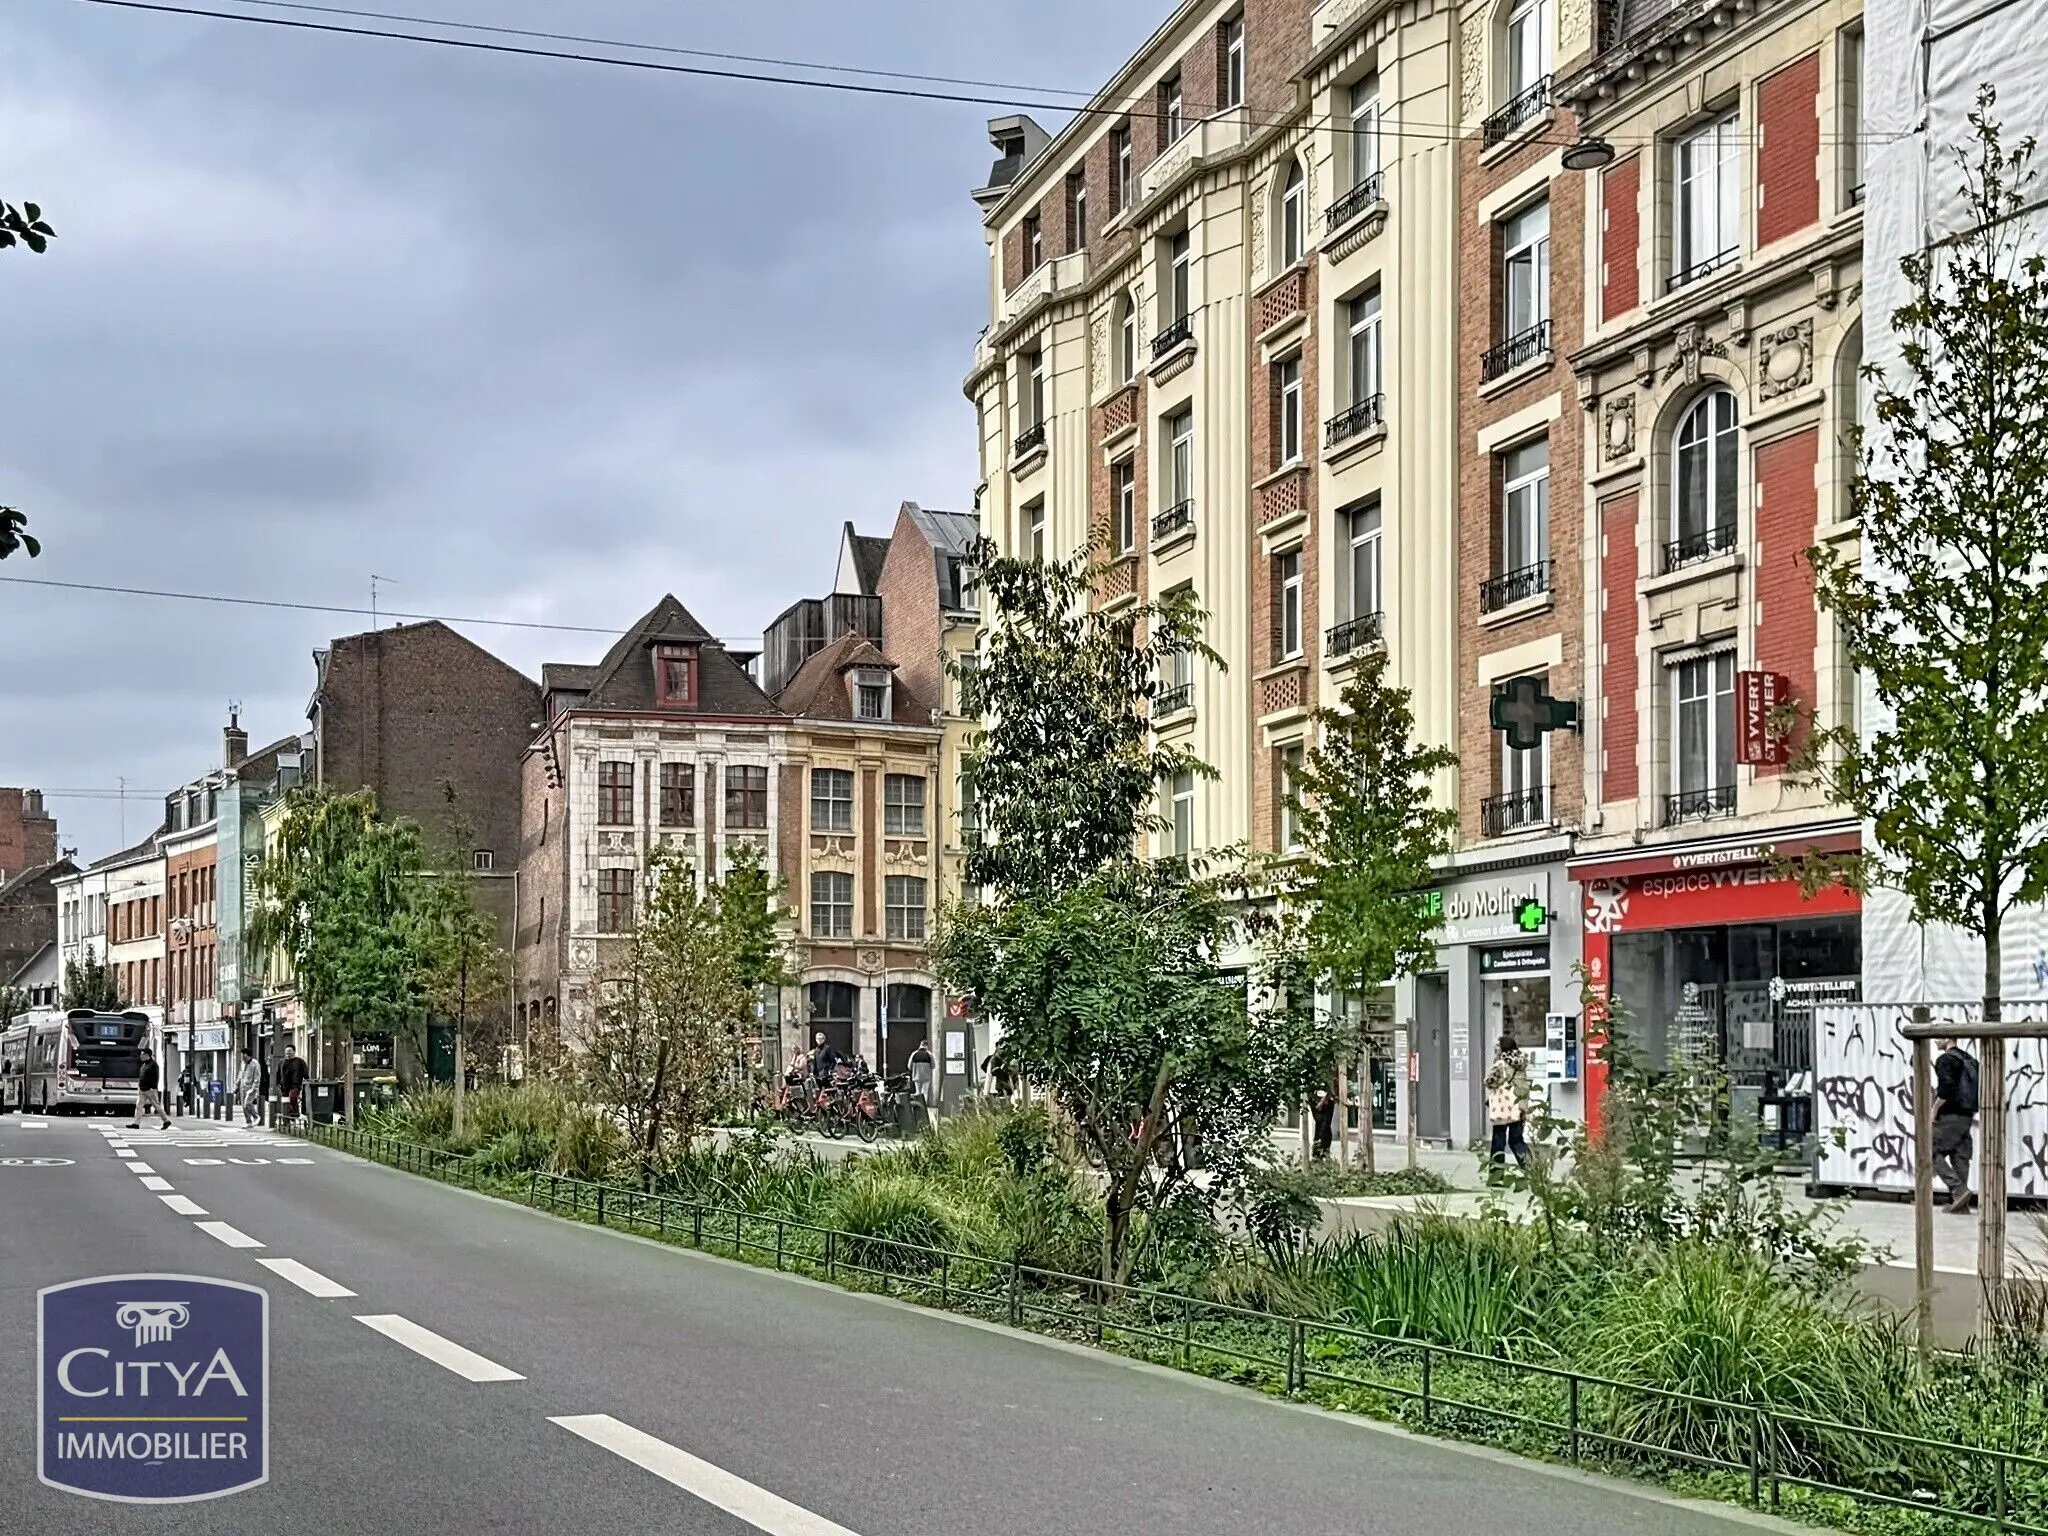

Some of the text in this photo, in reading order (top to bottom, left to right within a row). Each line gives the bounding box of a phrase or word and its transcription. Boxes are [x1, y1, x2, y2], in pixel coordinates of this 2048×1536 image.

[1748, 674, 1760, 738] YVERT
[1642, 873, 1710, 899] espace
[1449, 892, 1471, 919] du
